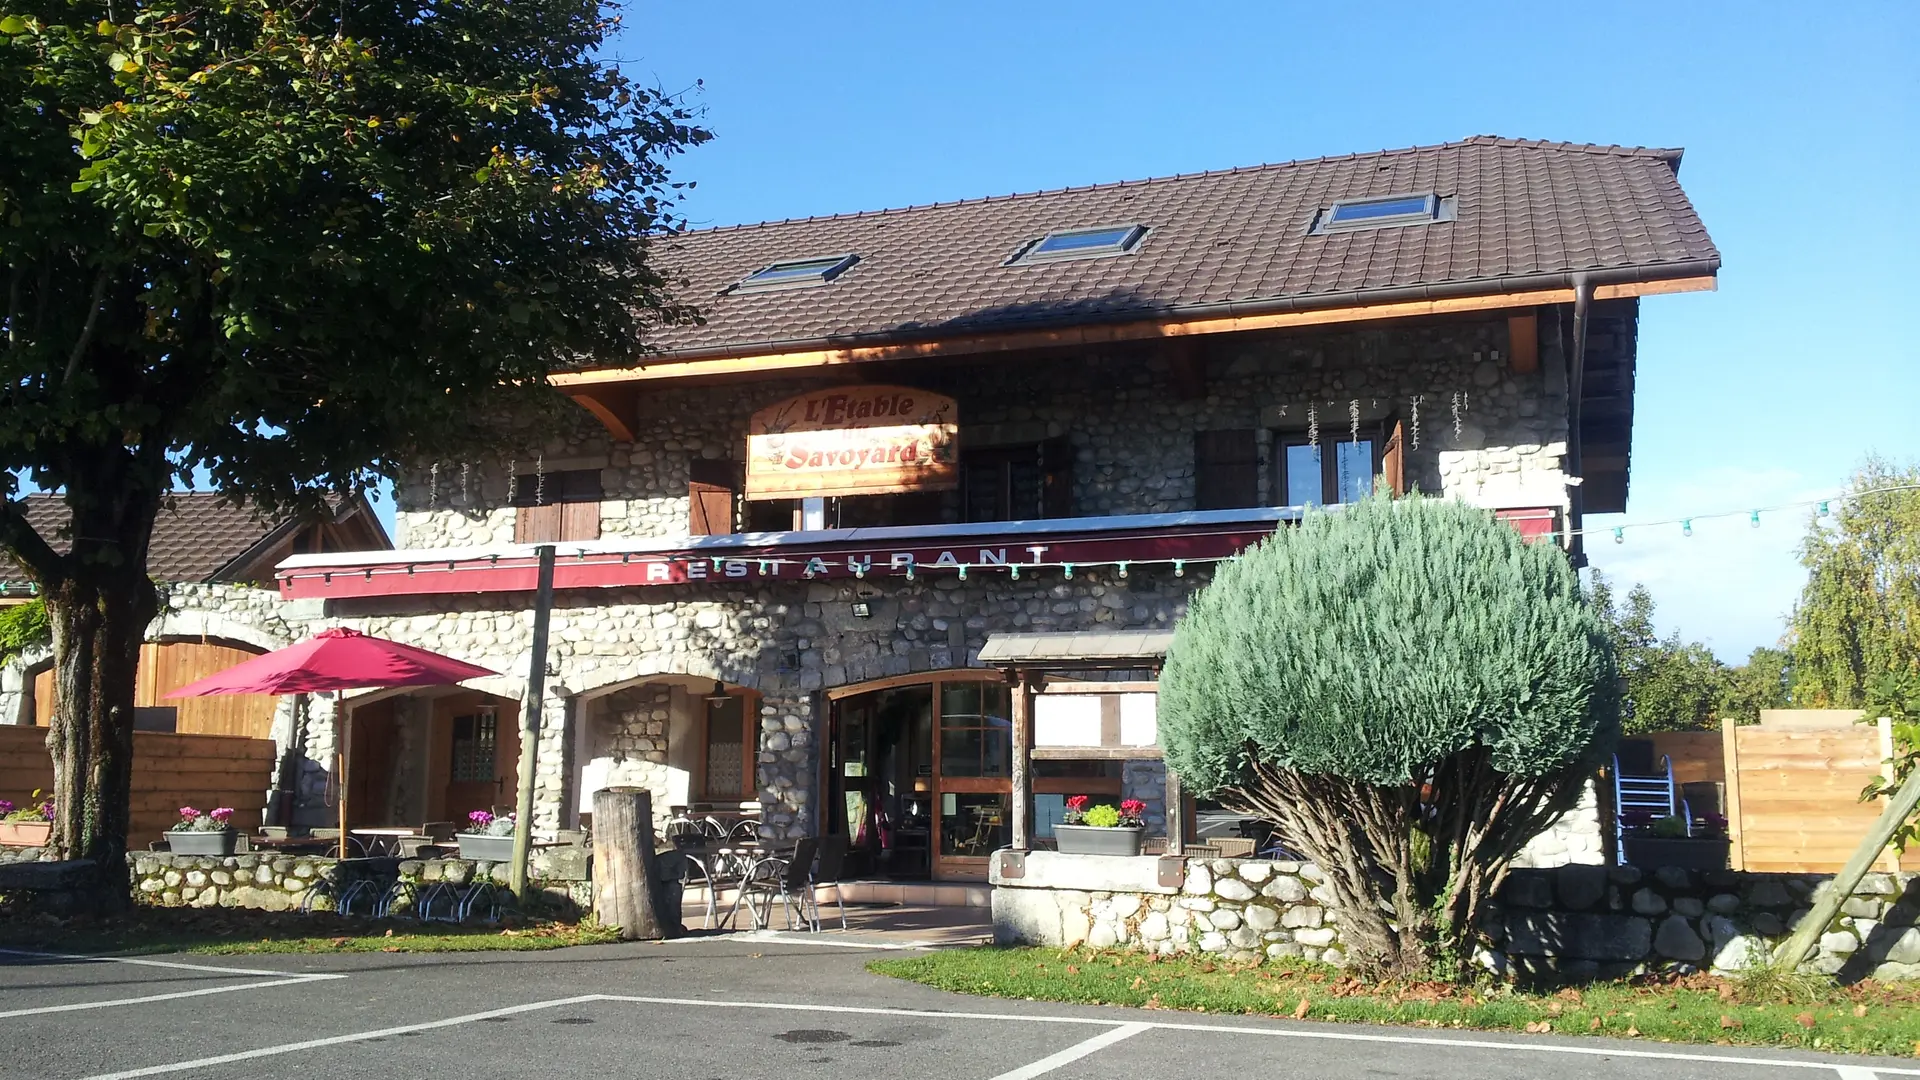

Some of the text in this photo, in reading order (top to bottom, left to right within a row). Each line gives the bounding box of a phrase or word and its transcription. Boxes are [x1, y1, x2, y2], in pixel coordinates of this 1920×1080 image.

[804, 394, 914, 425] L'Etable
[784, 439, 919, 469] Savoyard
[646, 546, 1049, 581] RESTAURANT
